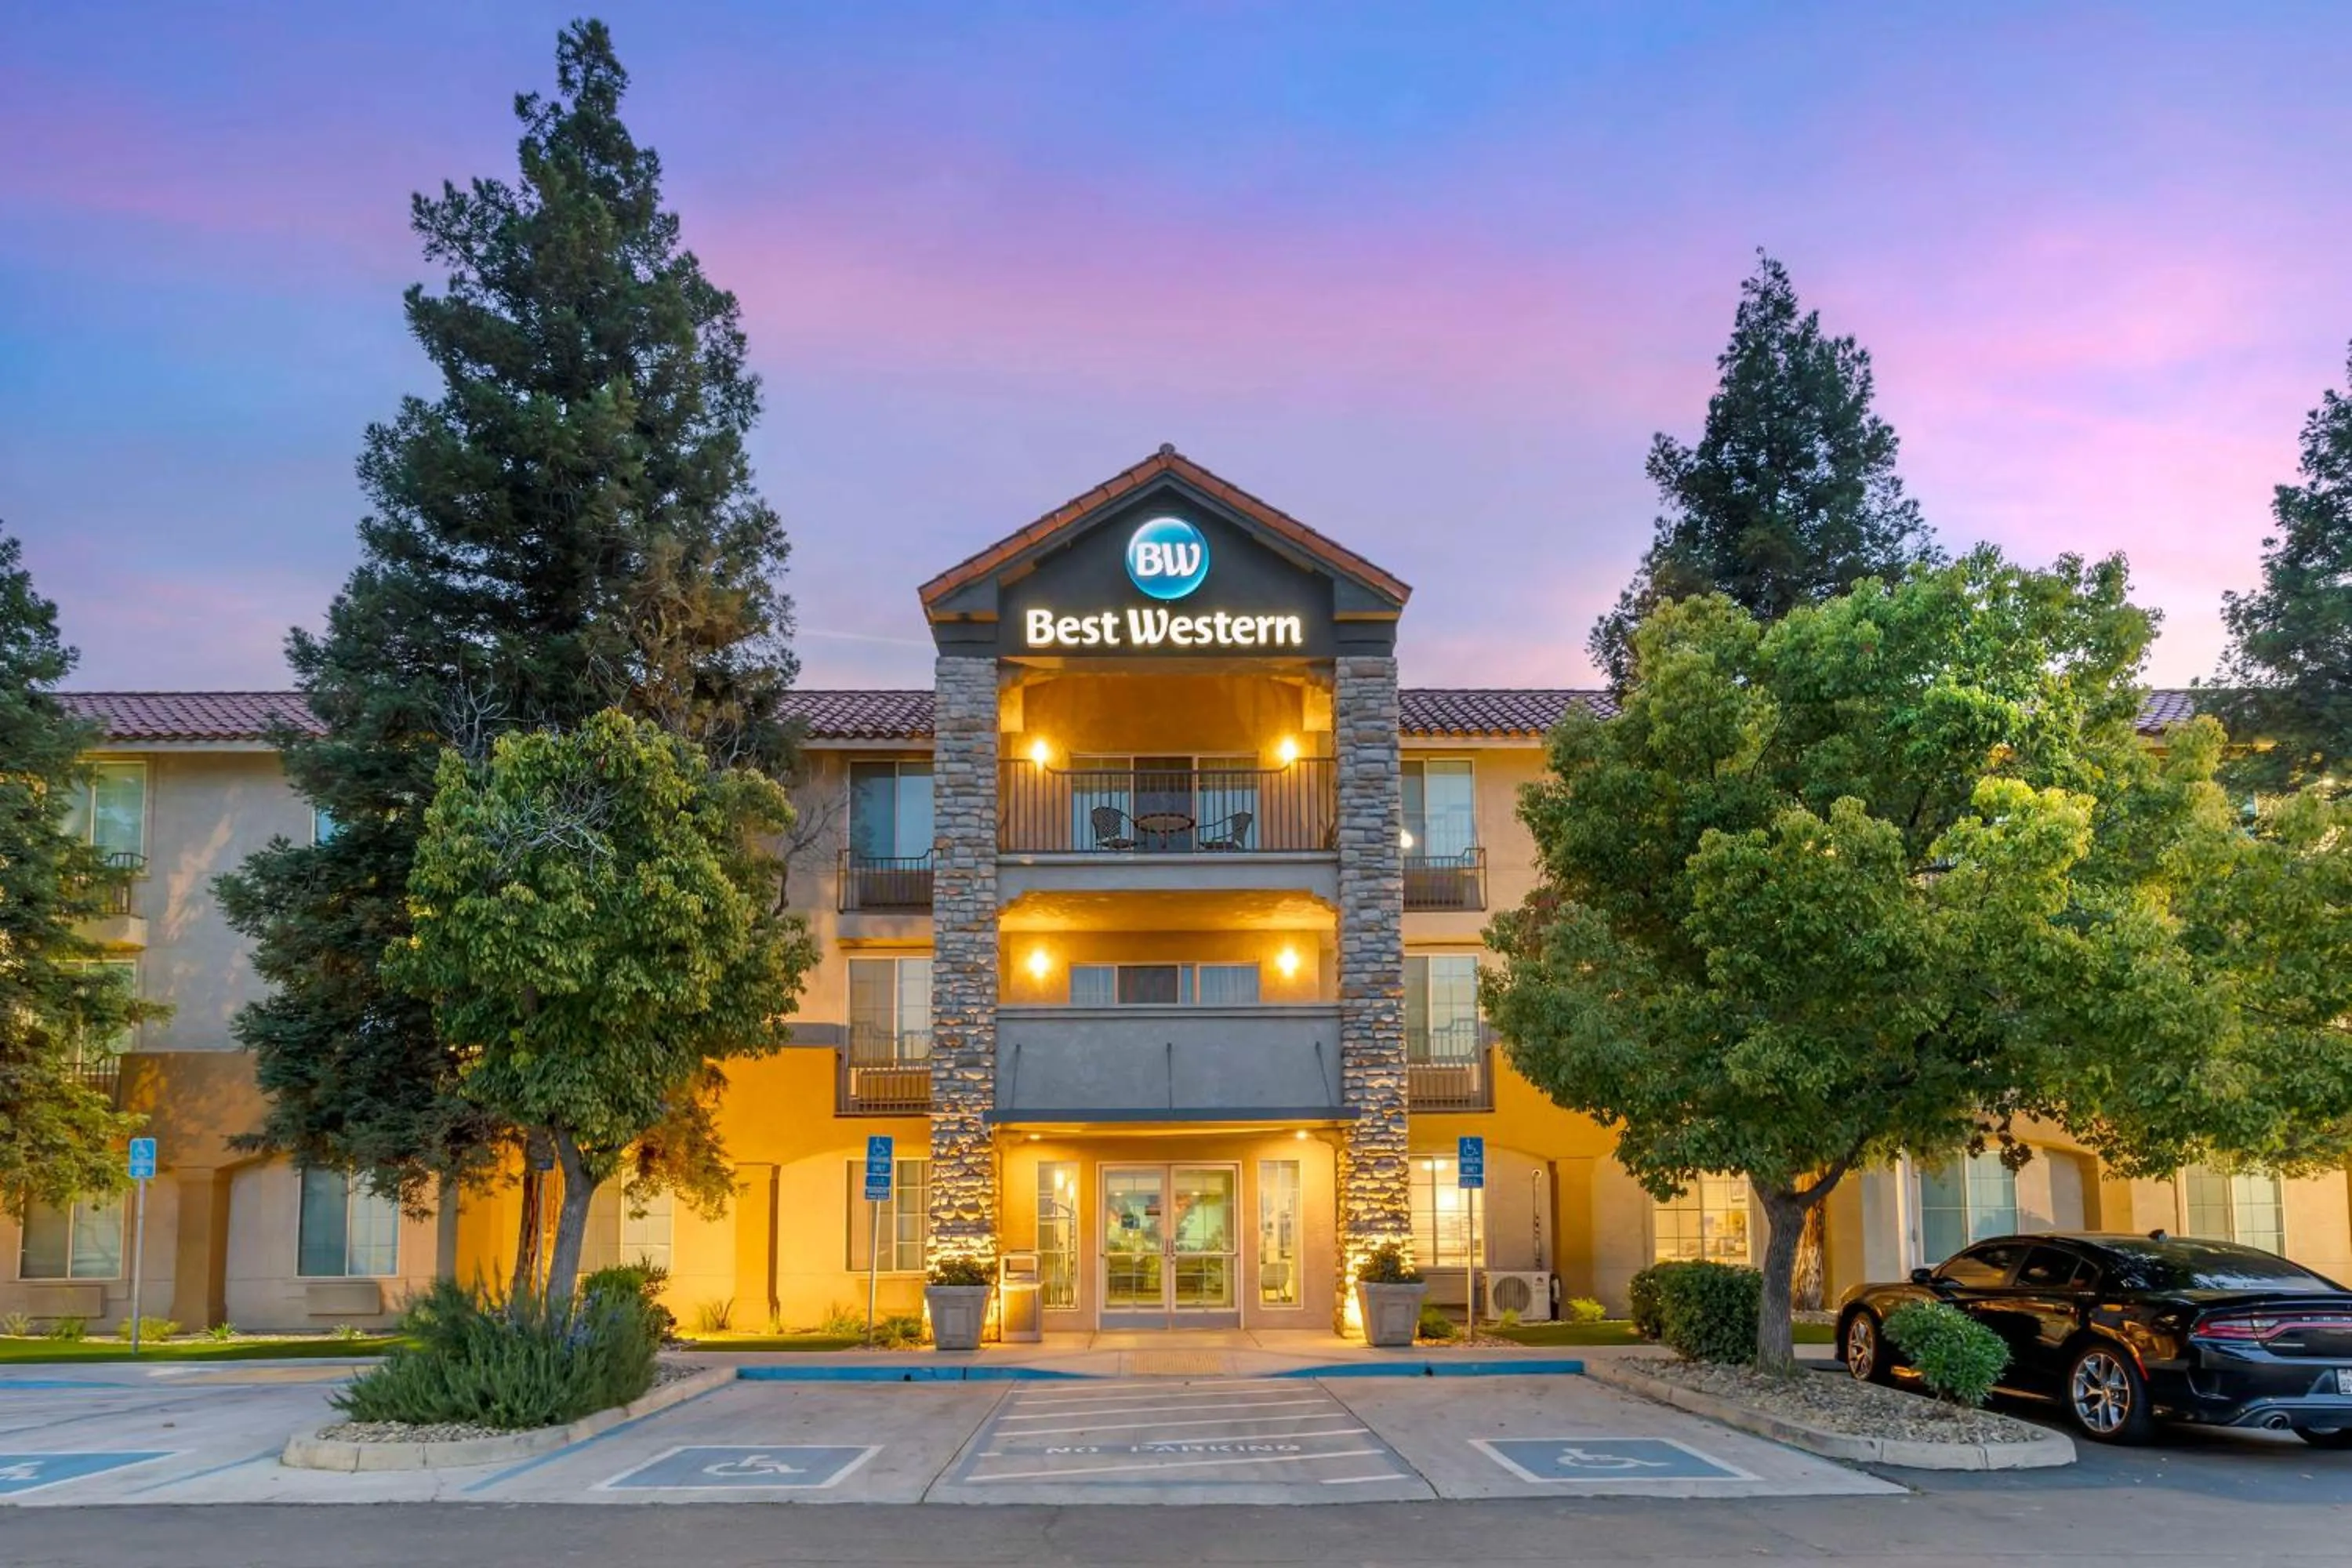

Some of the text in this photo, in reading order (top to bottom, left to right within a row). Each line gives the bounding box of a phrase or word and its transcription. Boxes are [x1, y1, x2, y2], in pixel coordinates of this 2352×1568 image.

[1137, 543, 1201, 576] BW
[1025, 608, 1303, 645] Best Western
[1045, 1443, 1301, 1454] NO PARKING
